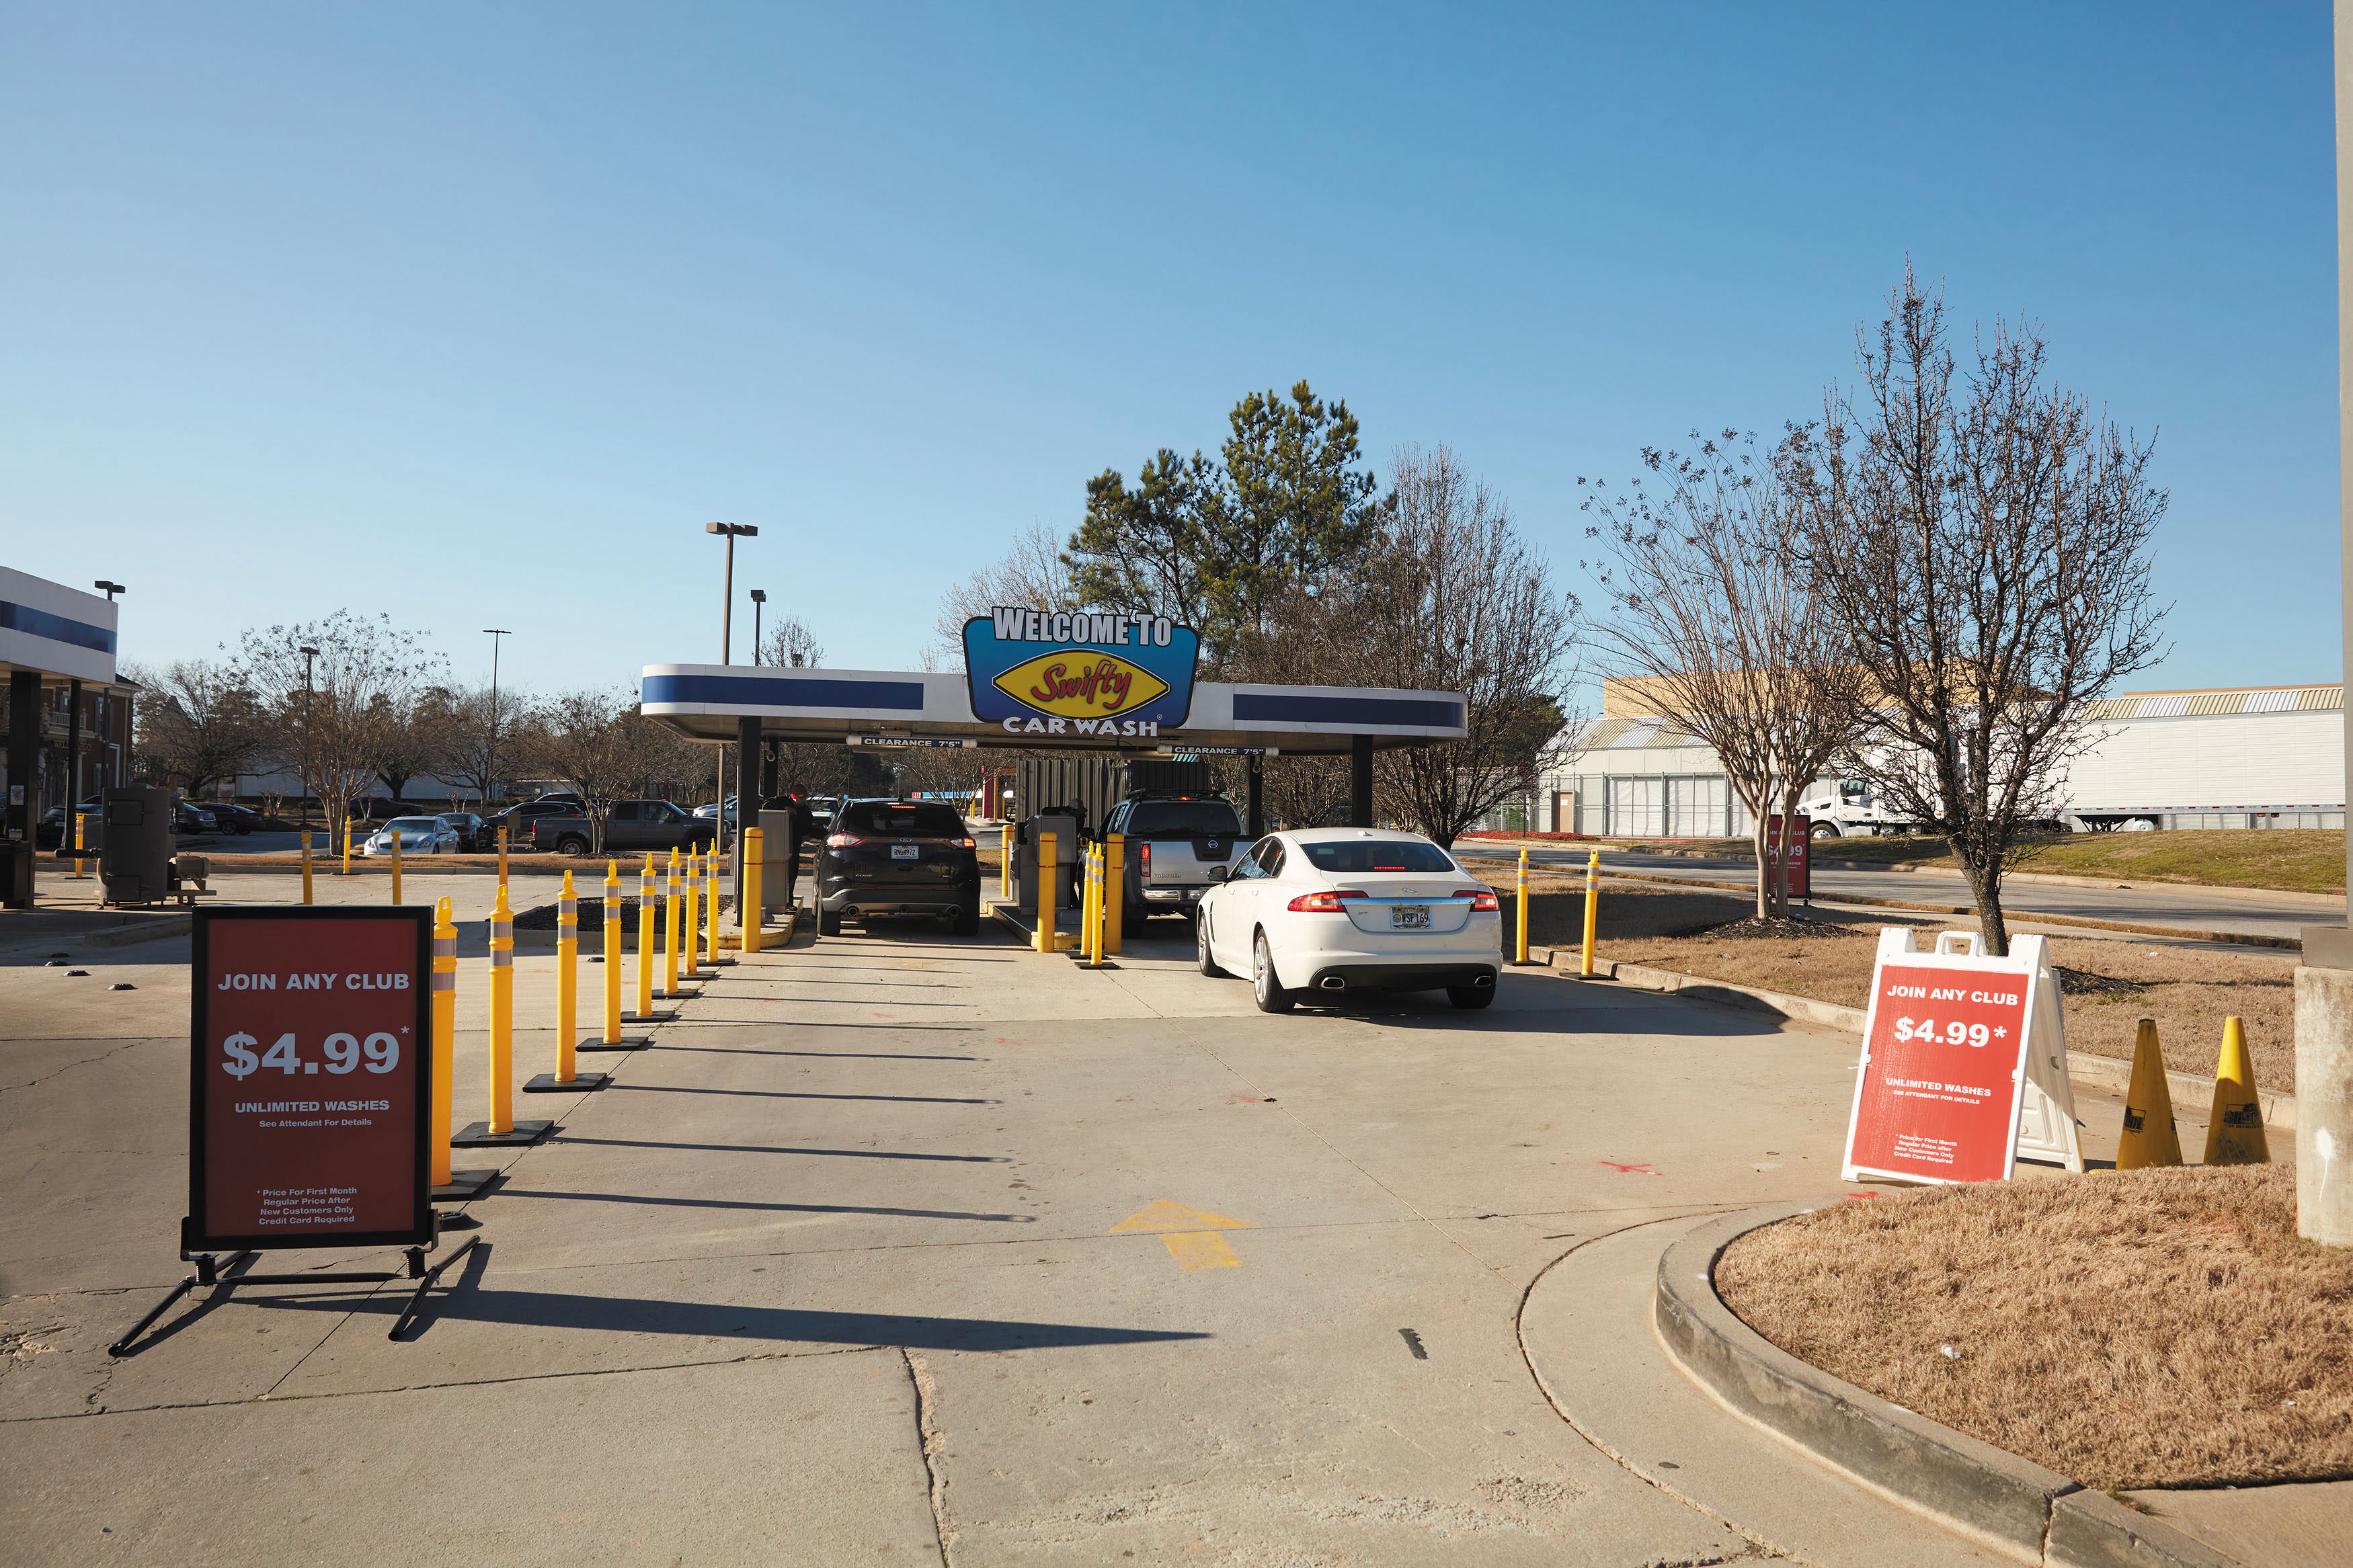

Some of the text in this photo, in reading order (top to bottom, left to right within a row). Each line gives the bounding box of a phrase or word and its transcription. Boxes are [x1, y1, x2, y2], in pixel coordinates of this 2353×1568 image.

[992, 607, 1172, 647] WELCOME TO
[1031, 659, 1131, 709] Swifty
[1002, 716, 1158, 737] CAR WASH
[864, 738, 932, 747] CLEARANCE
[1174, 747, 1238, 755] CLEARANCE
[217, 973, 409, 991] JOIN ANY CLUB
[1886, 985, 2018, 1006] JOIN ANY CLUB
[1885, 1077, 1991, 1096] UNLIMITED WASHES
[1905, 1091, 1940, 1099] ATTENDANT
[235, 1100, 390, 1113] UNLIMITED WASHES
[279, 1119, 322, 1127] Attendant
[342, 1118, 372, 1126] Details
[1908, 1148, 1939, 1156] Customers
[1927, 1156, 1952, 1164] Required
[263, 1188, 288, 1196] Price
[329, 1187, 358, 1195] Month
[264, 1196, 351, 1207] Regular Price After
[282, 1206, 332, 1215] Customers
[334, 1206, 354, 1214] Only
[259, 1215, 355, 1225] Credit Card Required
